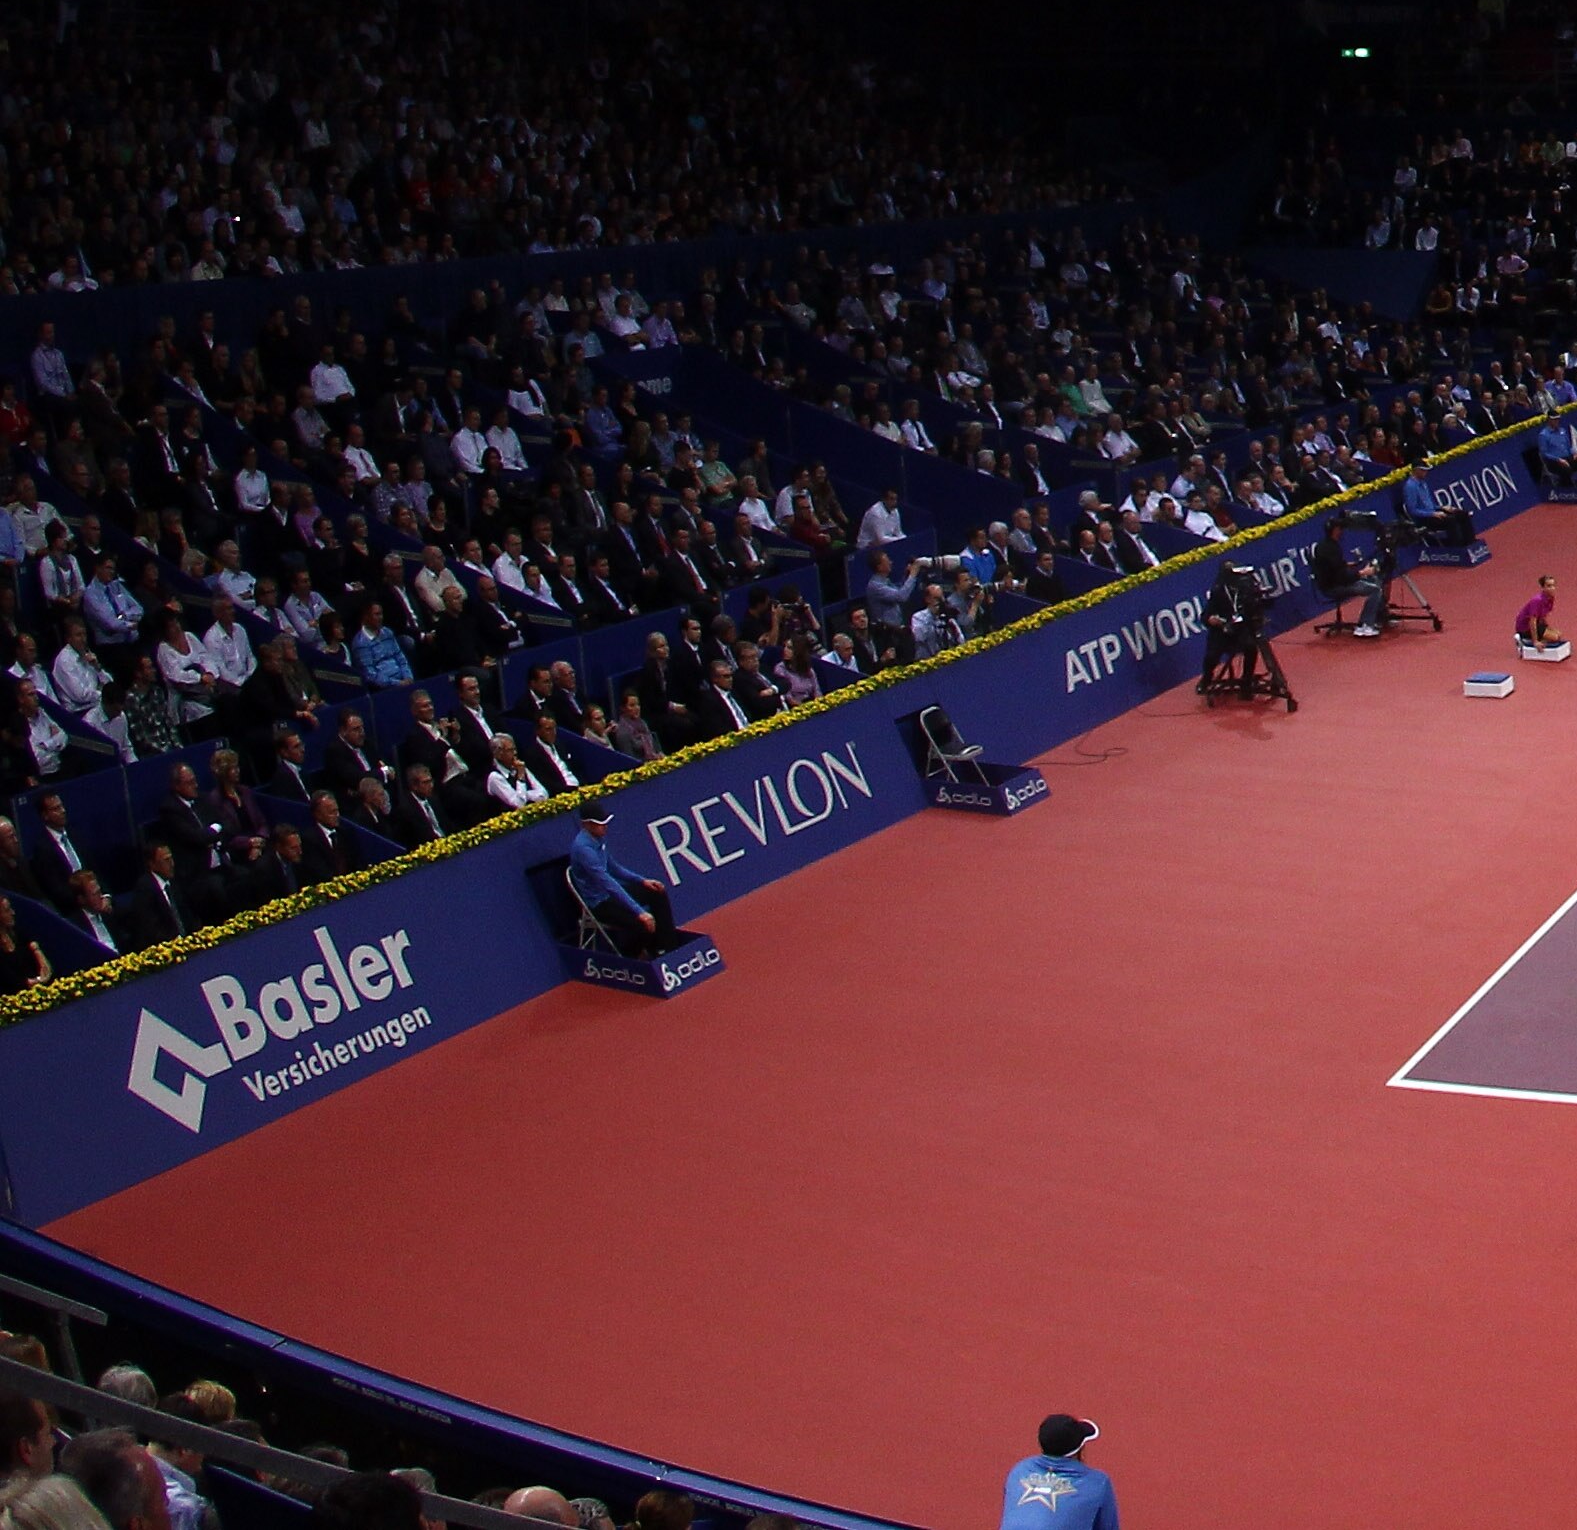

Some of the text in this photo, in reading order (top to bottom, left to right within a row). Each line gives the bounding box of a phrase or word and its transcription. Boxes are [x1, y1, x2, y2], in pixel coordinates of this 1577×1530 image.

[1433, 460, 1518, 512] REVLON
[1065, 633, 1121, 694] ATP
[1120, 591, 1212, 662] WORL
[647, 741, 872, 886] REVLON
[1016, 778, 1048, 802] odlo
[201, 926, 411, 1062] Basler
[601, 968, 645, 985] odlo
[677, 948, 720, 979] odlo
[243, 1003, 430, 1102] Versicherungen
